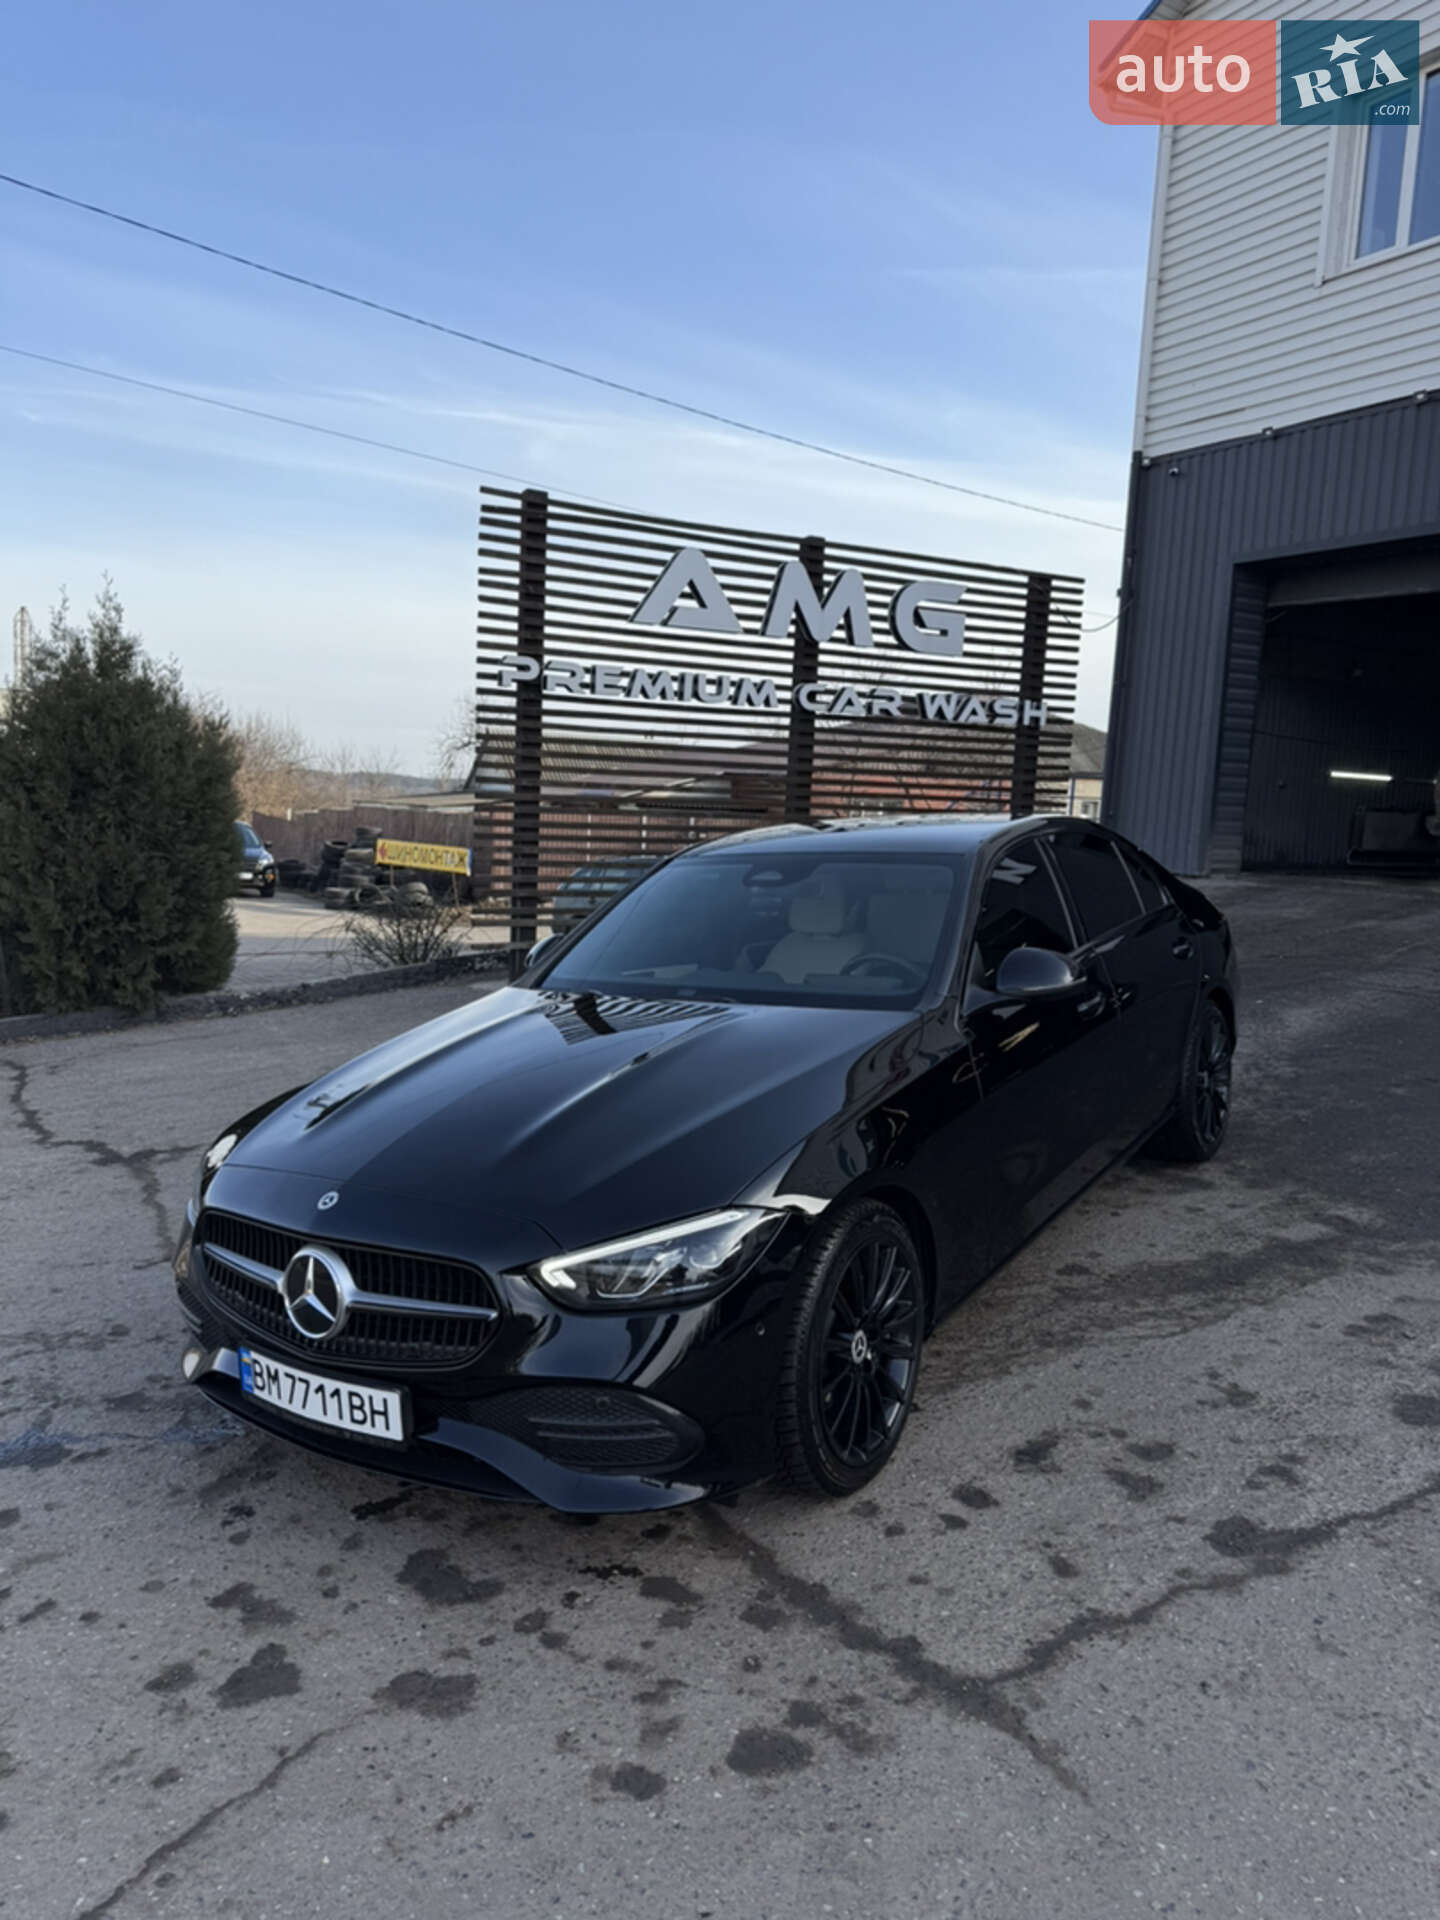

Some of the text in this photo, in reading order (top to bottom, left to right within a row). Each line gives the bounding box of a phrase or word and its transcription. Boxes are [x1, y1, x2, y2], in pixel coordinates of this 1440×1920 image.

[630, 547, 968, 657] AMG
[498, 655, 1049, 727] PREMIUM CAR WASH
[253, 1359, 390, 1431] BM7711BH
